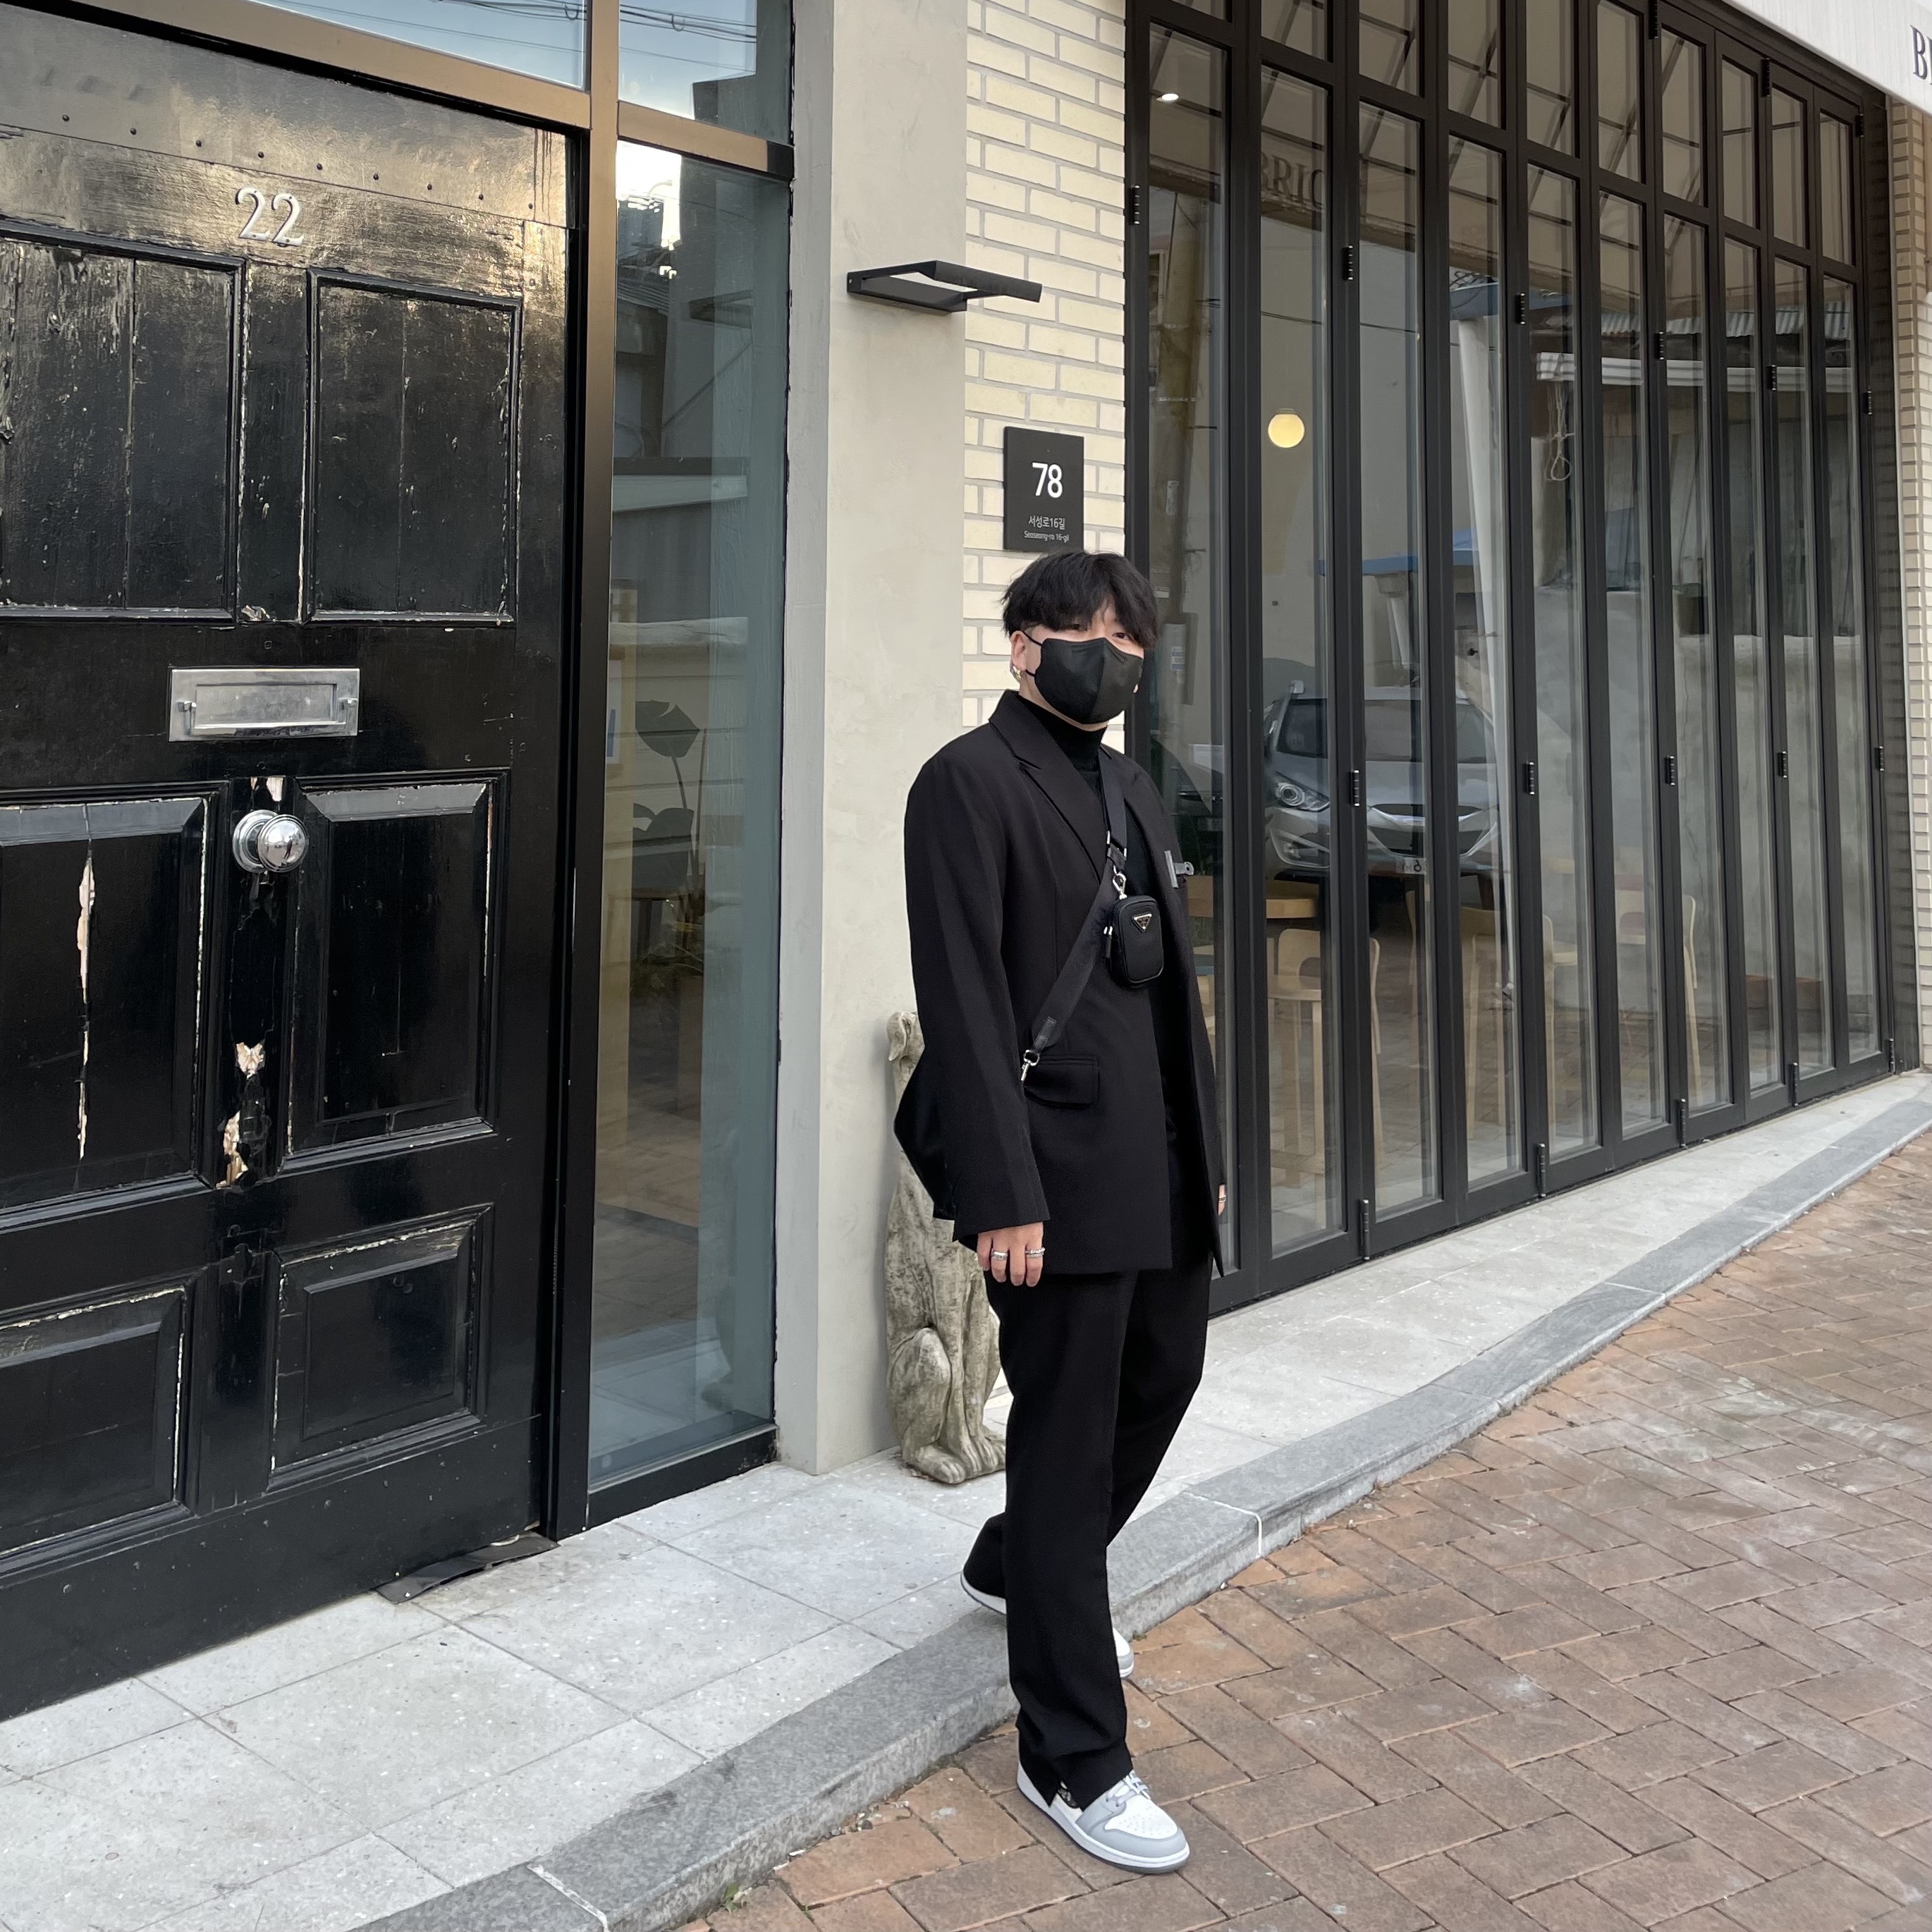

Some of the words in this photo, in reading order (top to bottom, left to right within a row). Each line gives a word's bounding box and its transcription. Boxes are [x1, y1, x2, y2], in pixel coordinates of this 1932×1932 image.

[235, 185, 305, 247] 22
[1032, 462, 1063, 498] 78
[1028, 515, 1065, 530] 서성로16길
